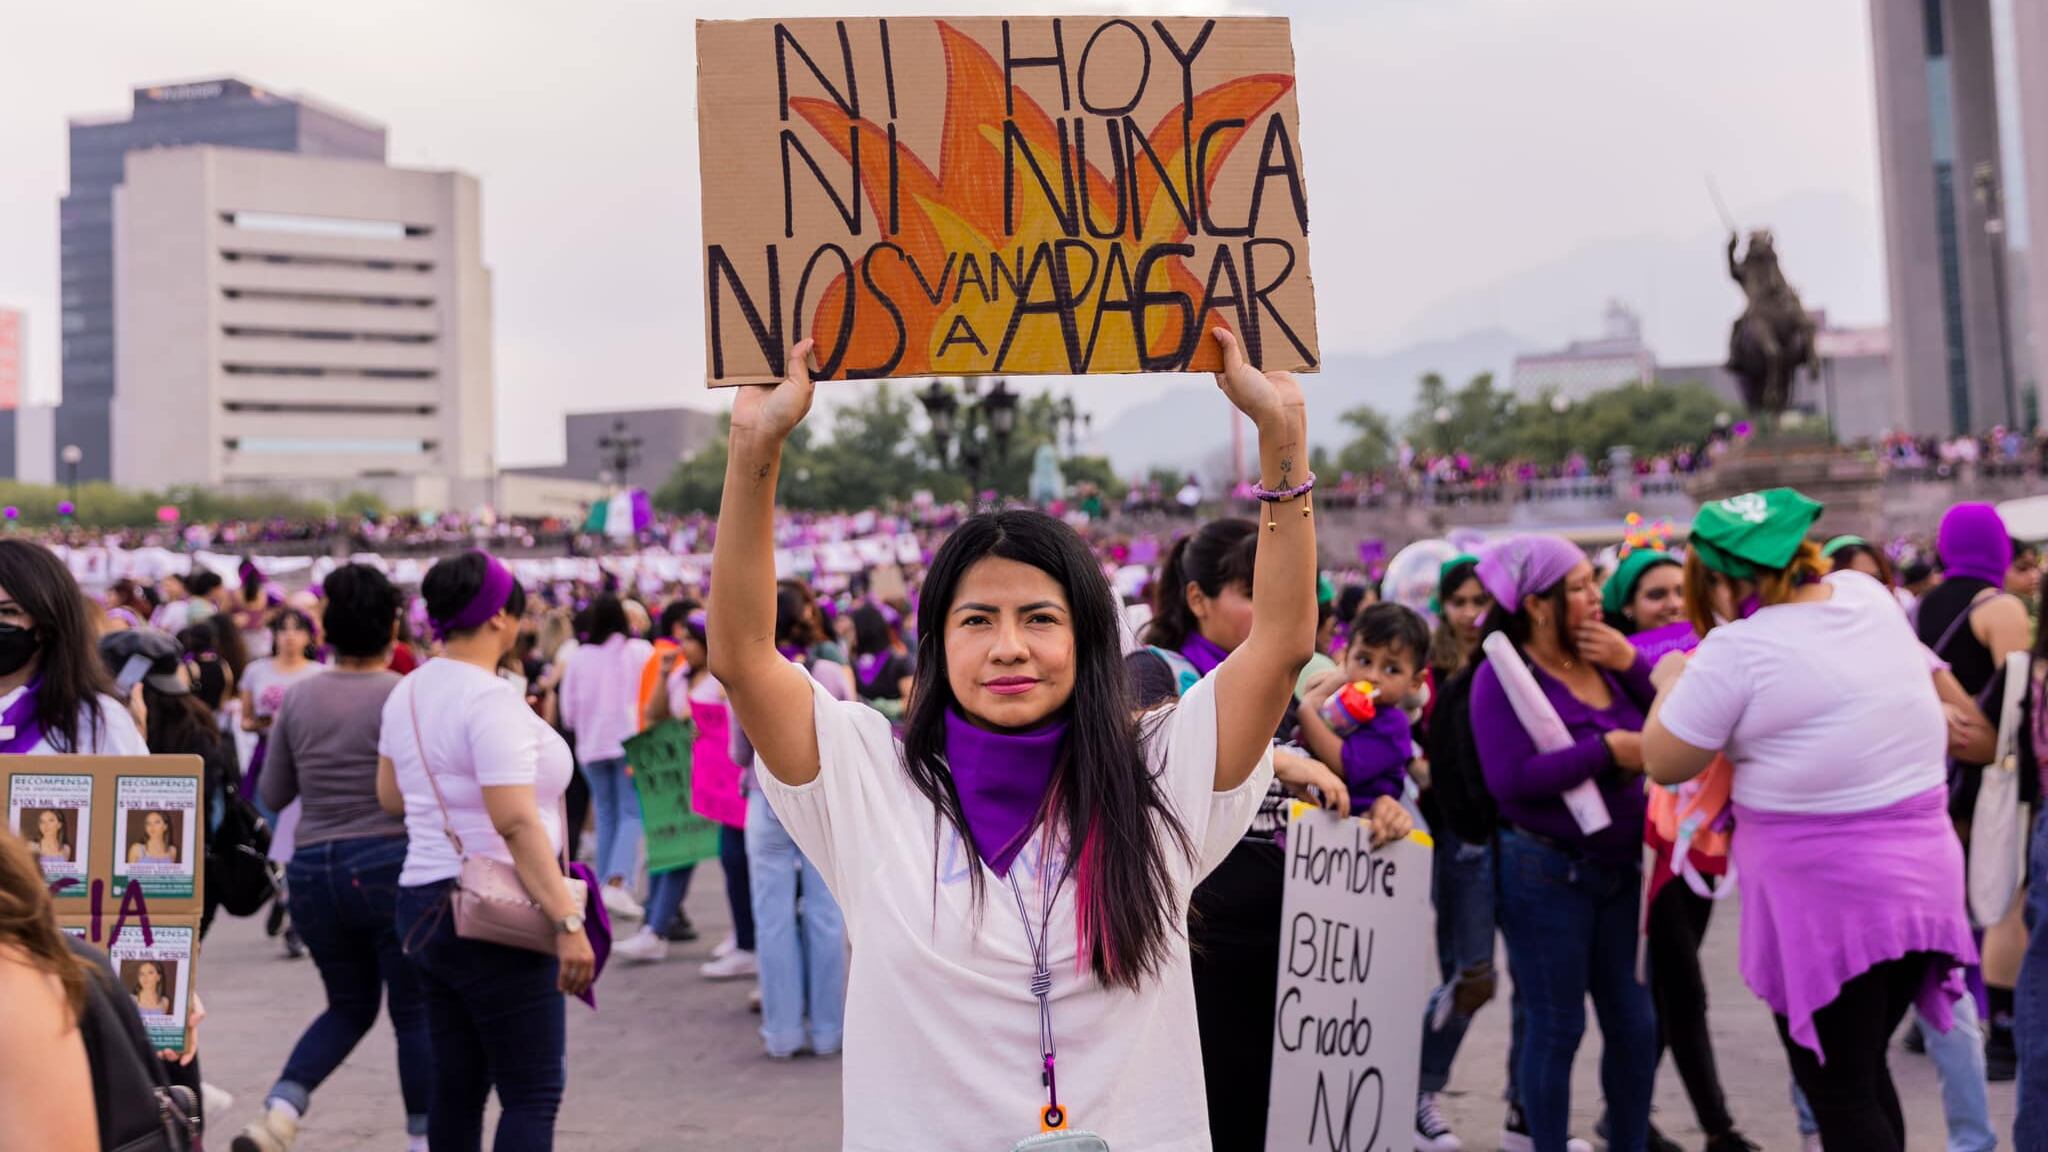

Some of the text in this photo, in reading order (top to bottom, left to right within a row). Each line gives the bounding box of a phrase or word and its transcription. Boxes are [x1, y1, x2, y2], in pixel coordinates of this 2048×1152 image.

[774, 18, 1216, 121] NI HOY
[780, 112, 1309, 241] NI NUNCA
[708, 238, 1317, 381] NOS VAN A APAGAR
[14, 777, 90, 786] RECOMPENSA
[121, 779, 195, 788] RECOMPENSA
[1292, 824, 1397, 898] Hombre
[1287, 912, 1374, 984] BIEN
[1278, 986, 1372, 1057] Criado
